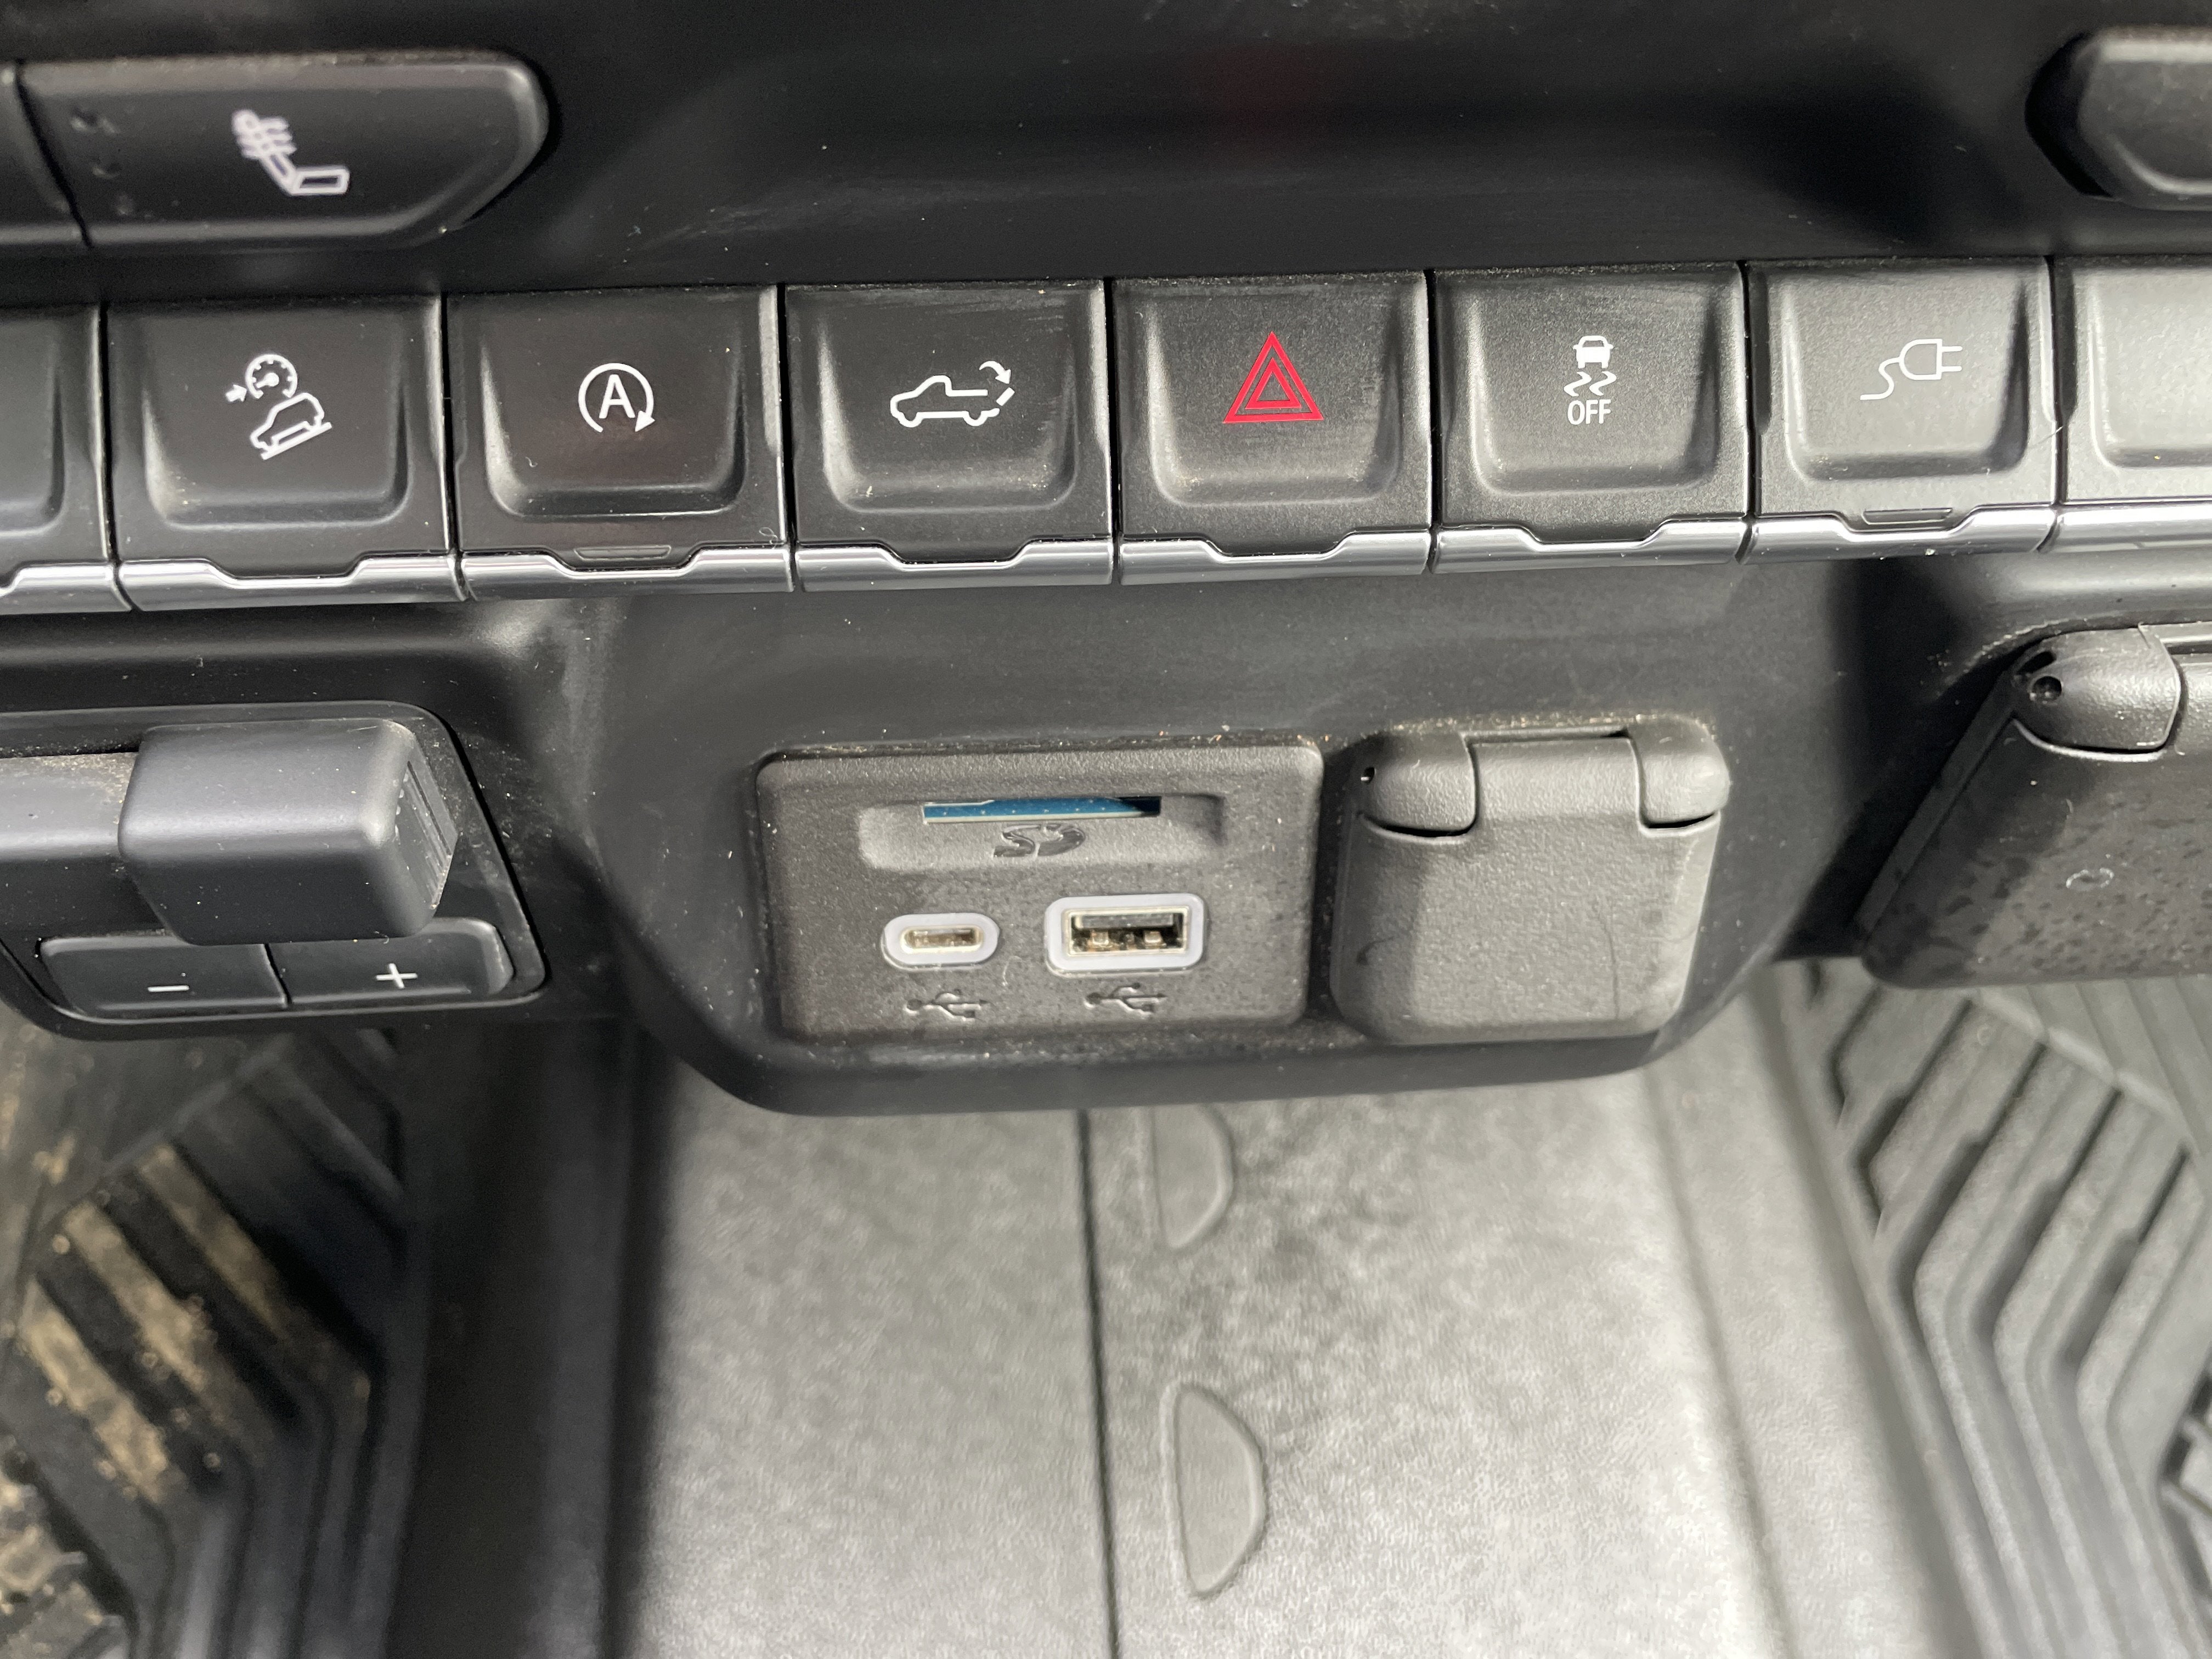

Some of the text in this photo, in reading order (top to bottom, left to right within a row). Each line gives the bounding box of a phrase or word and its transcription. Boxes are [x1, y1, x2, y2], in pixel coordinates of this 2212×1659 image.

[599, 374, 635, 419] A
[1567, 399, 1612, 425] OFF
[992, 823, 1086, 857] SD
